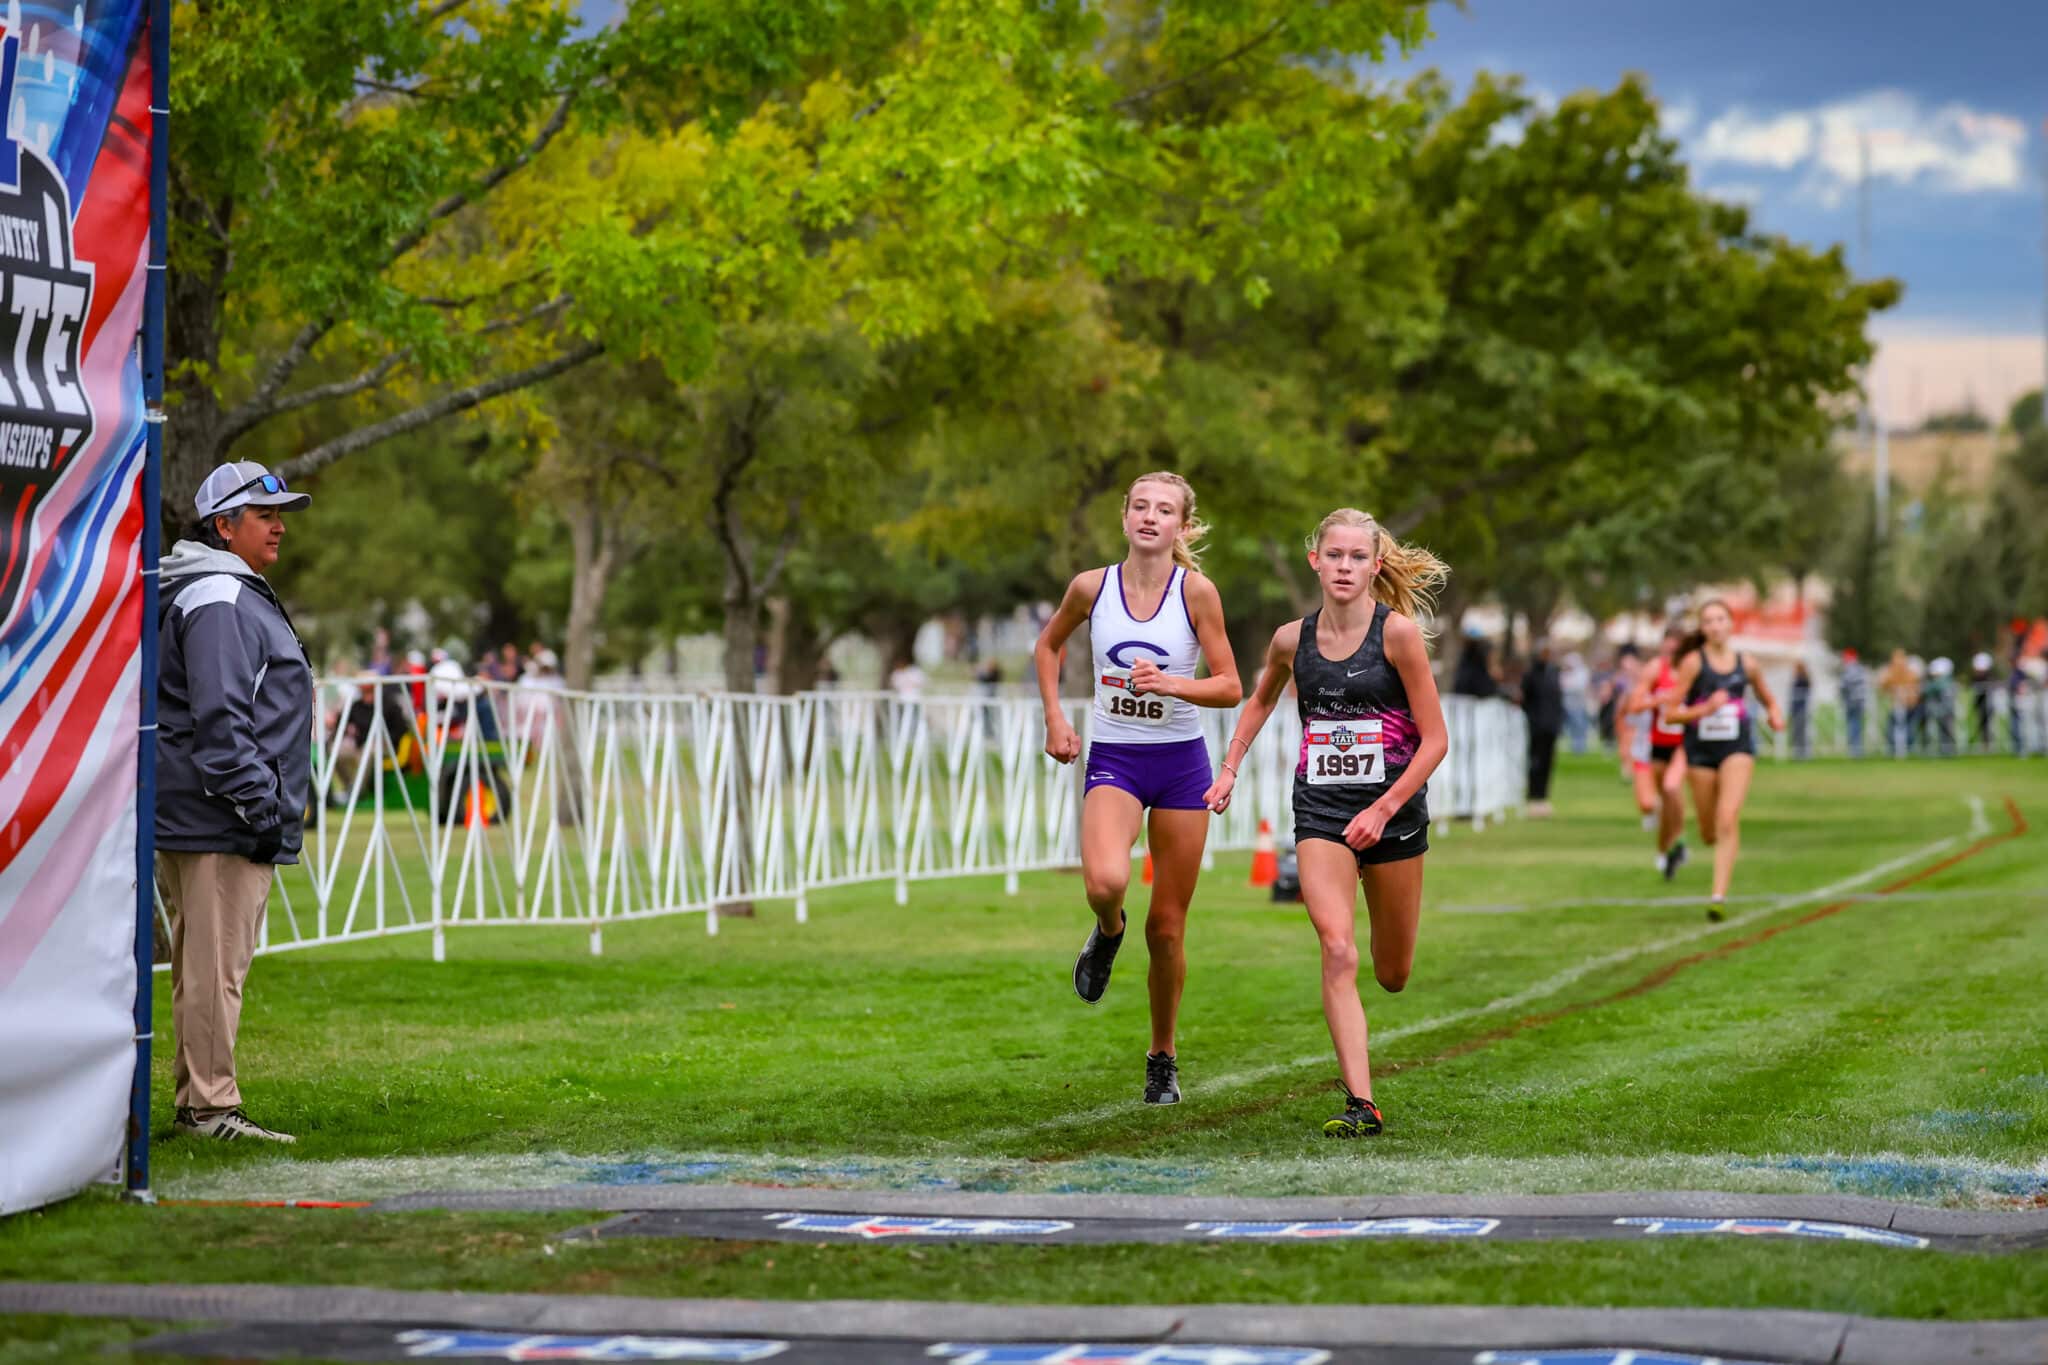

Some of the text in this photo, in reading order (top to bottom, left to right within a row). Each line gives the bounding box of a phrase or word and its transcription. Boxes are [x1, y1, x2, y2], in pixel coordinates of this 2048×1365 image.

[1105, 641, 1170, 670] C
[1110, 696, 1164, 720] 1916
[1316, 754, 1375, 777] 1997
